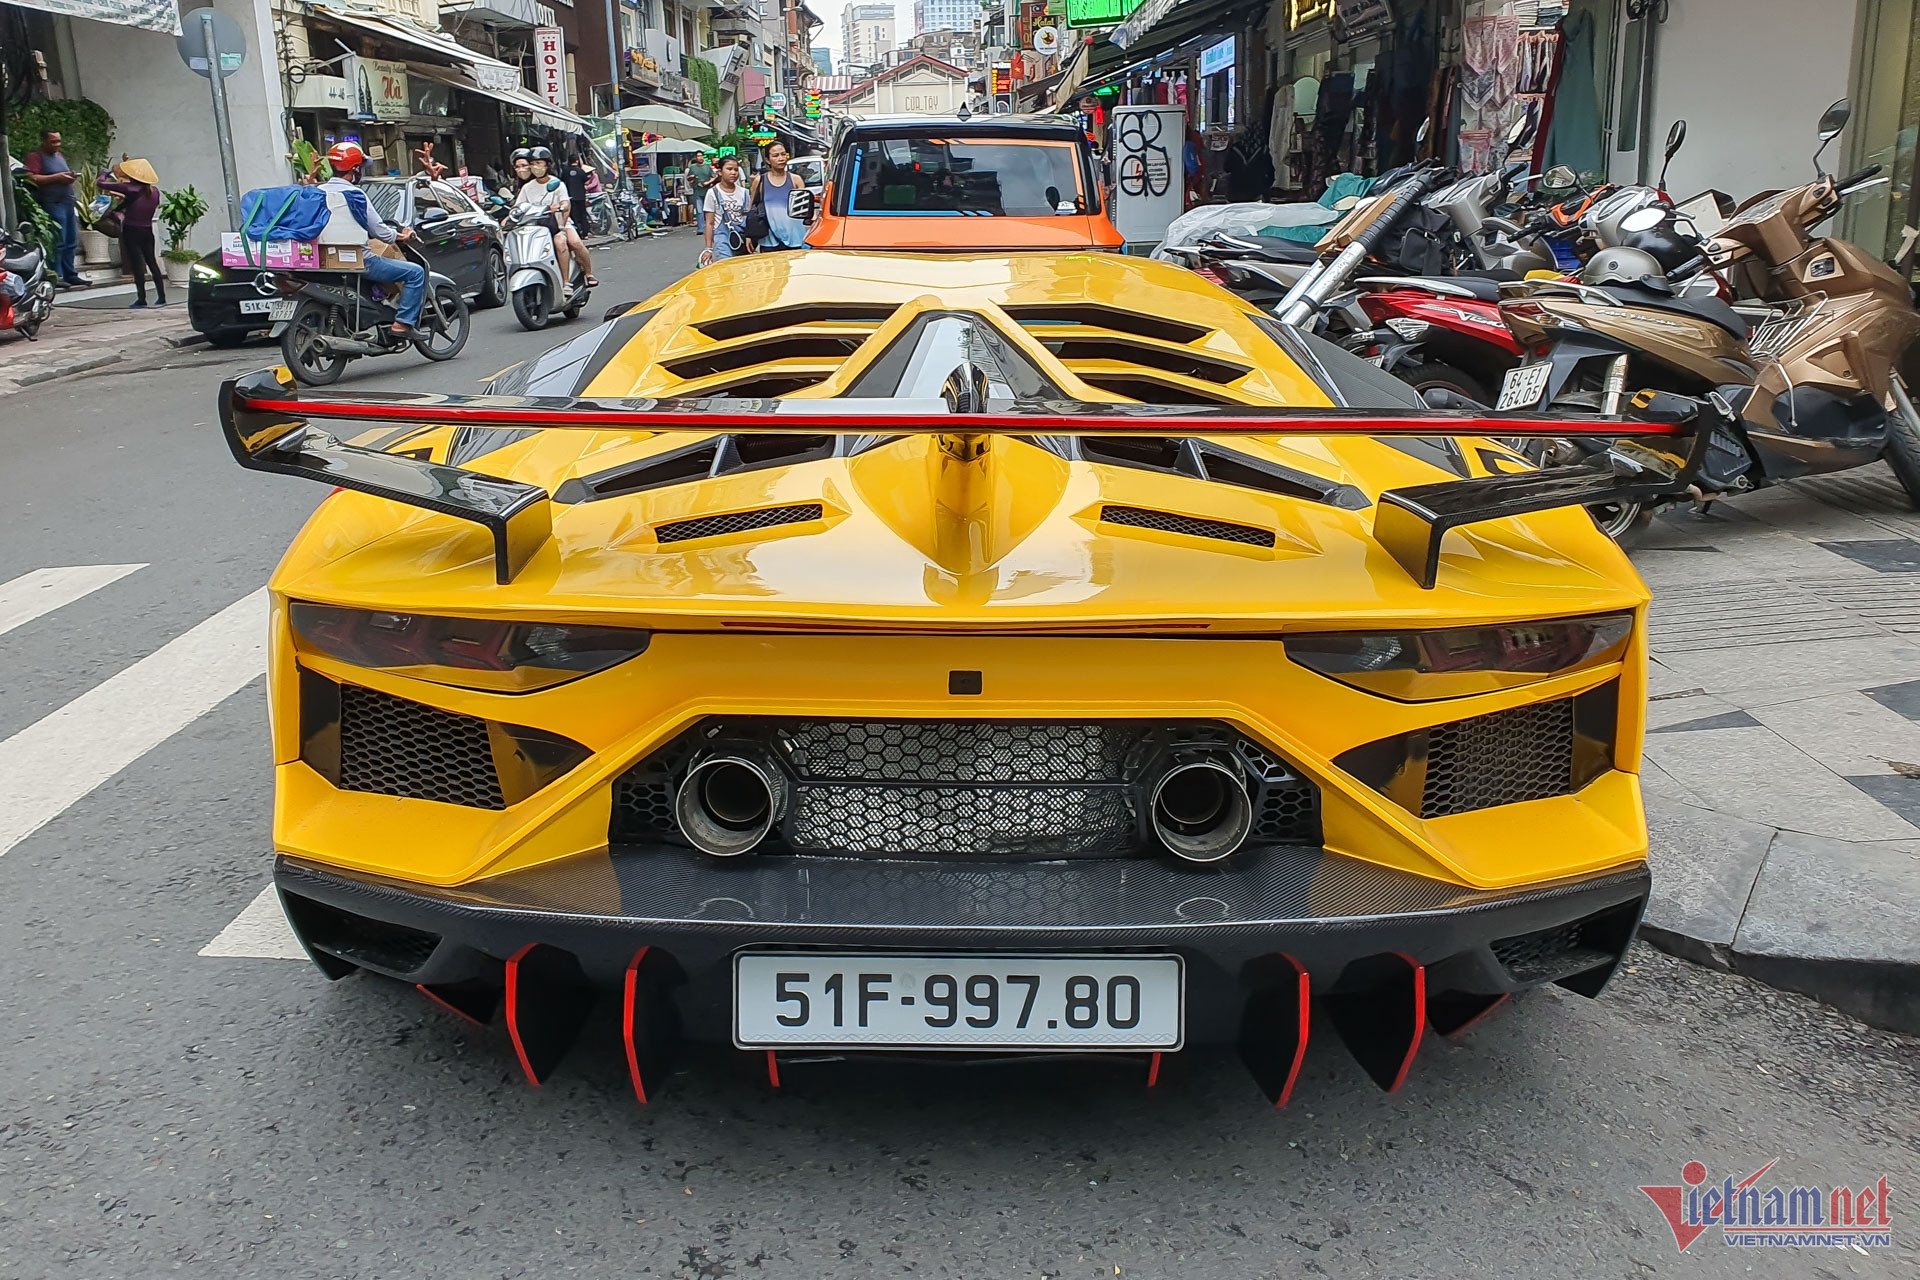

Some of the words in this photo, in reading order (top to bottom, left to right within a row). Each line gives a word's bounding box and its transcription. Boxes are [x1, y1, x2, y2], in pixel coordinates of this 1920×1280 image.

[1032, 16, 1055, 28] Halal
[543, 41, 559, 105] HOTEL
[382, 75, 402, 100] Hà
[1509, 367, 1543, 390] 64-E1
[1499, 385, 1540, 410] 264.05
[775, 972, 1140, 1029] 51F-997.80
